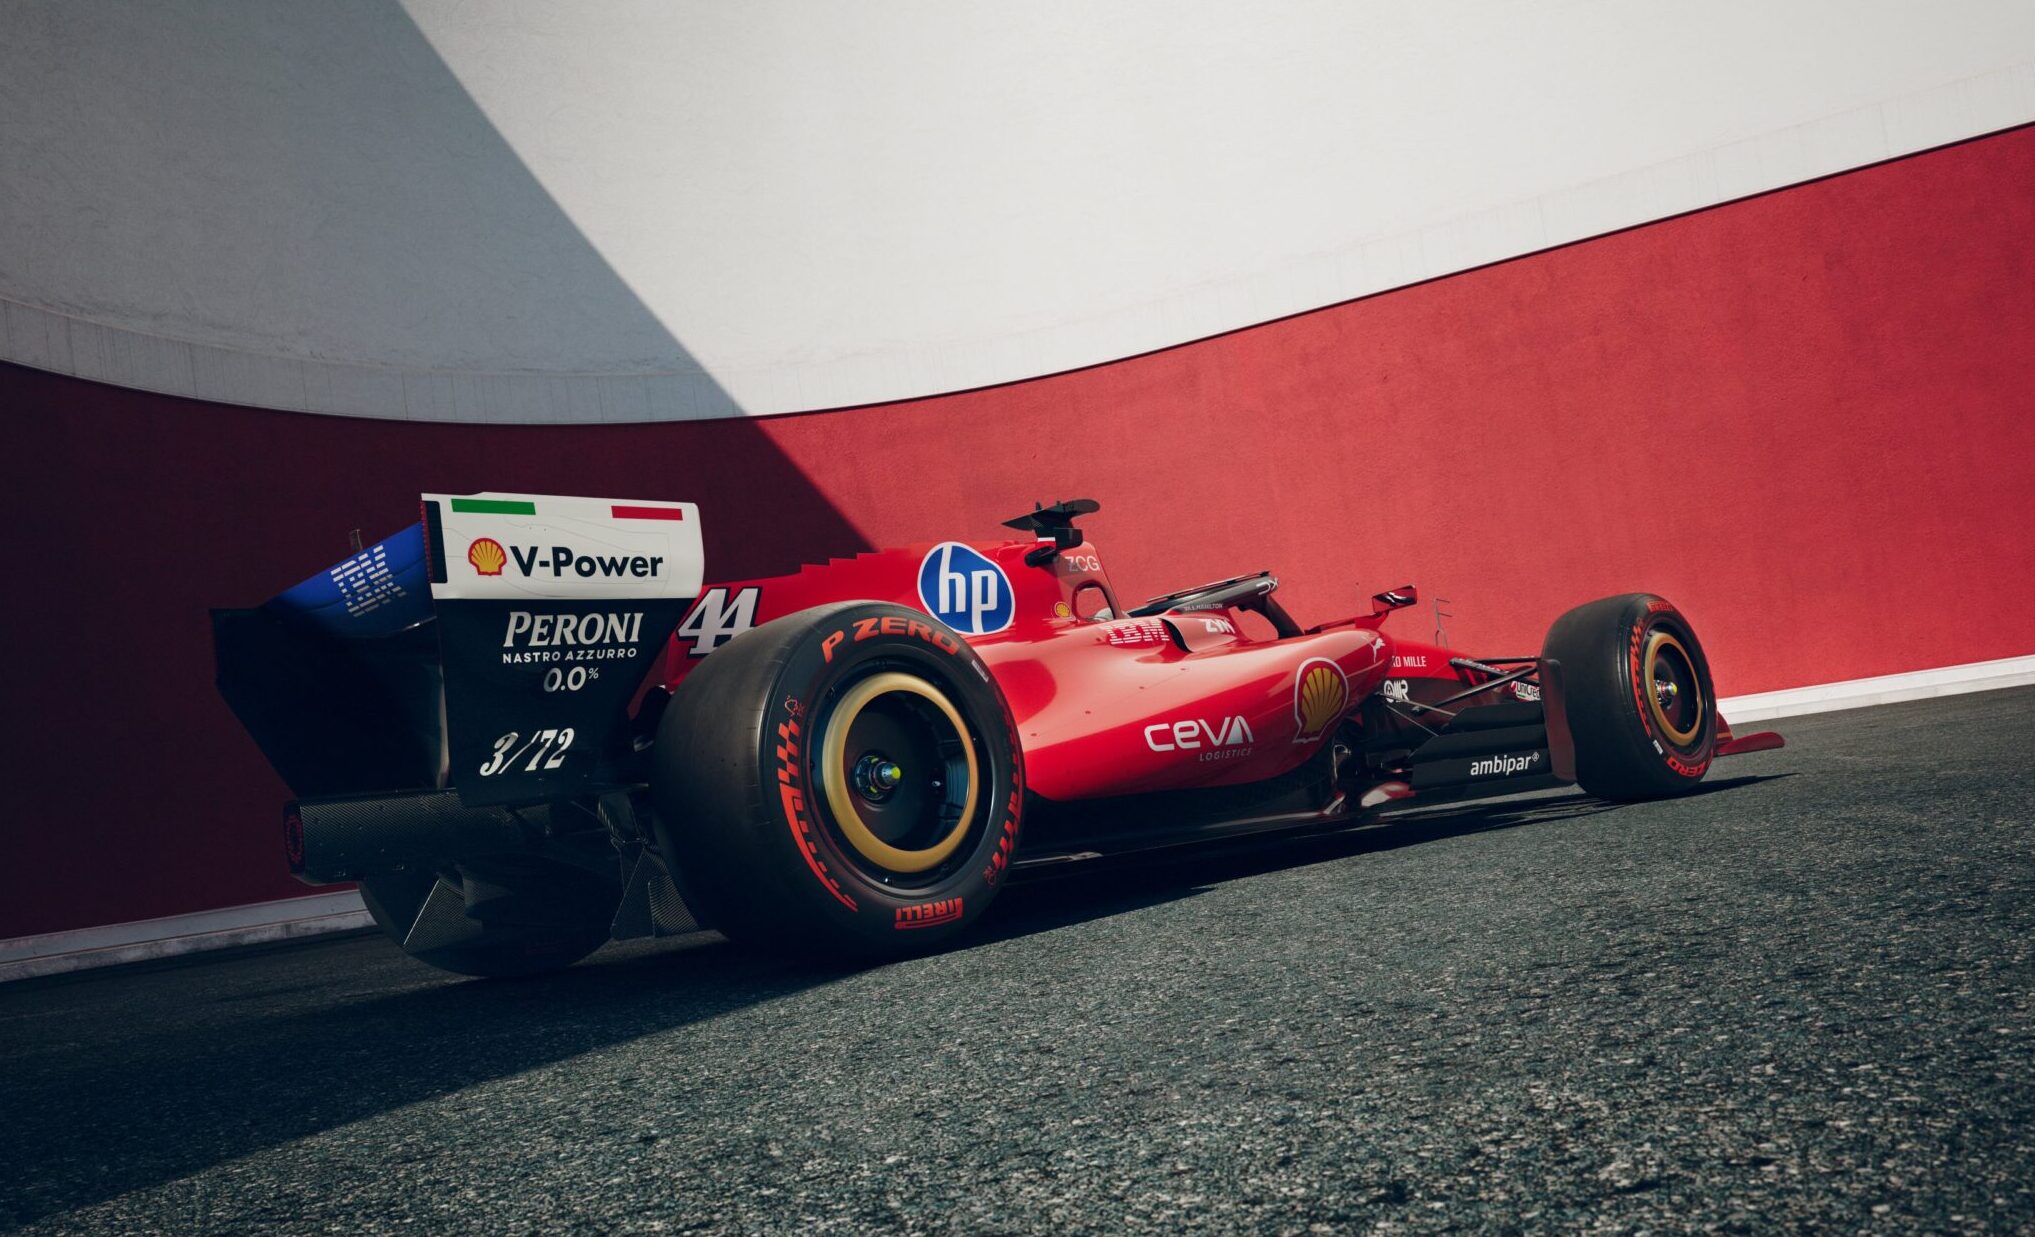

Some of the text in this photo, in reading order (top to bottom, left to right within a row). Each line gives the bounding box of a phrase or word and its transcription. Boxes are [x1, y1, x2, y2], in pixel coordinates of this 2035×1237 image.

[510, 546, 663, 577] V-Power
[1065, 556, 1100, 571] ZCG
[331, 545, 407, 617] IBM
[939, 543, 998, 634] hp
[503, 611, 644, 647] PERONI
[677, 587, 760, 655] 44
[1100, 620, 1170, 645] IBM
[502, 648, 637, 664] NASTRO AZZURRO
[822, 616, 961, 664] P ZERO
[1402, 655, 1427, 668] MILLE
[479, 727, 575, 777] 3/72
[894, 896, 963, 930] PIRELLI
